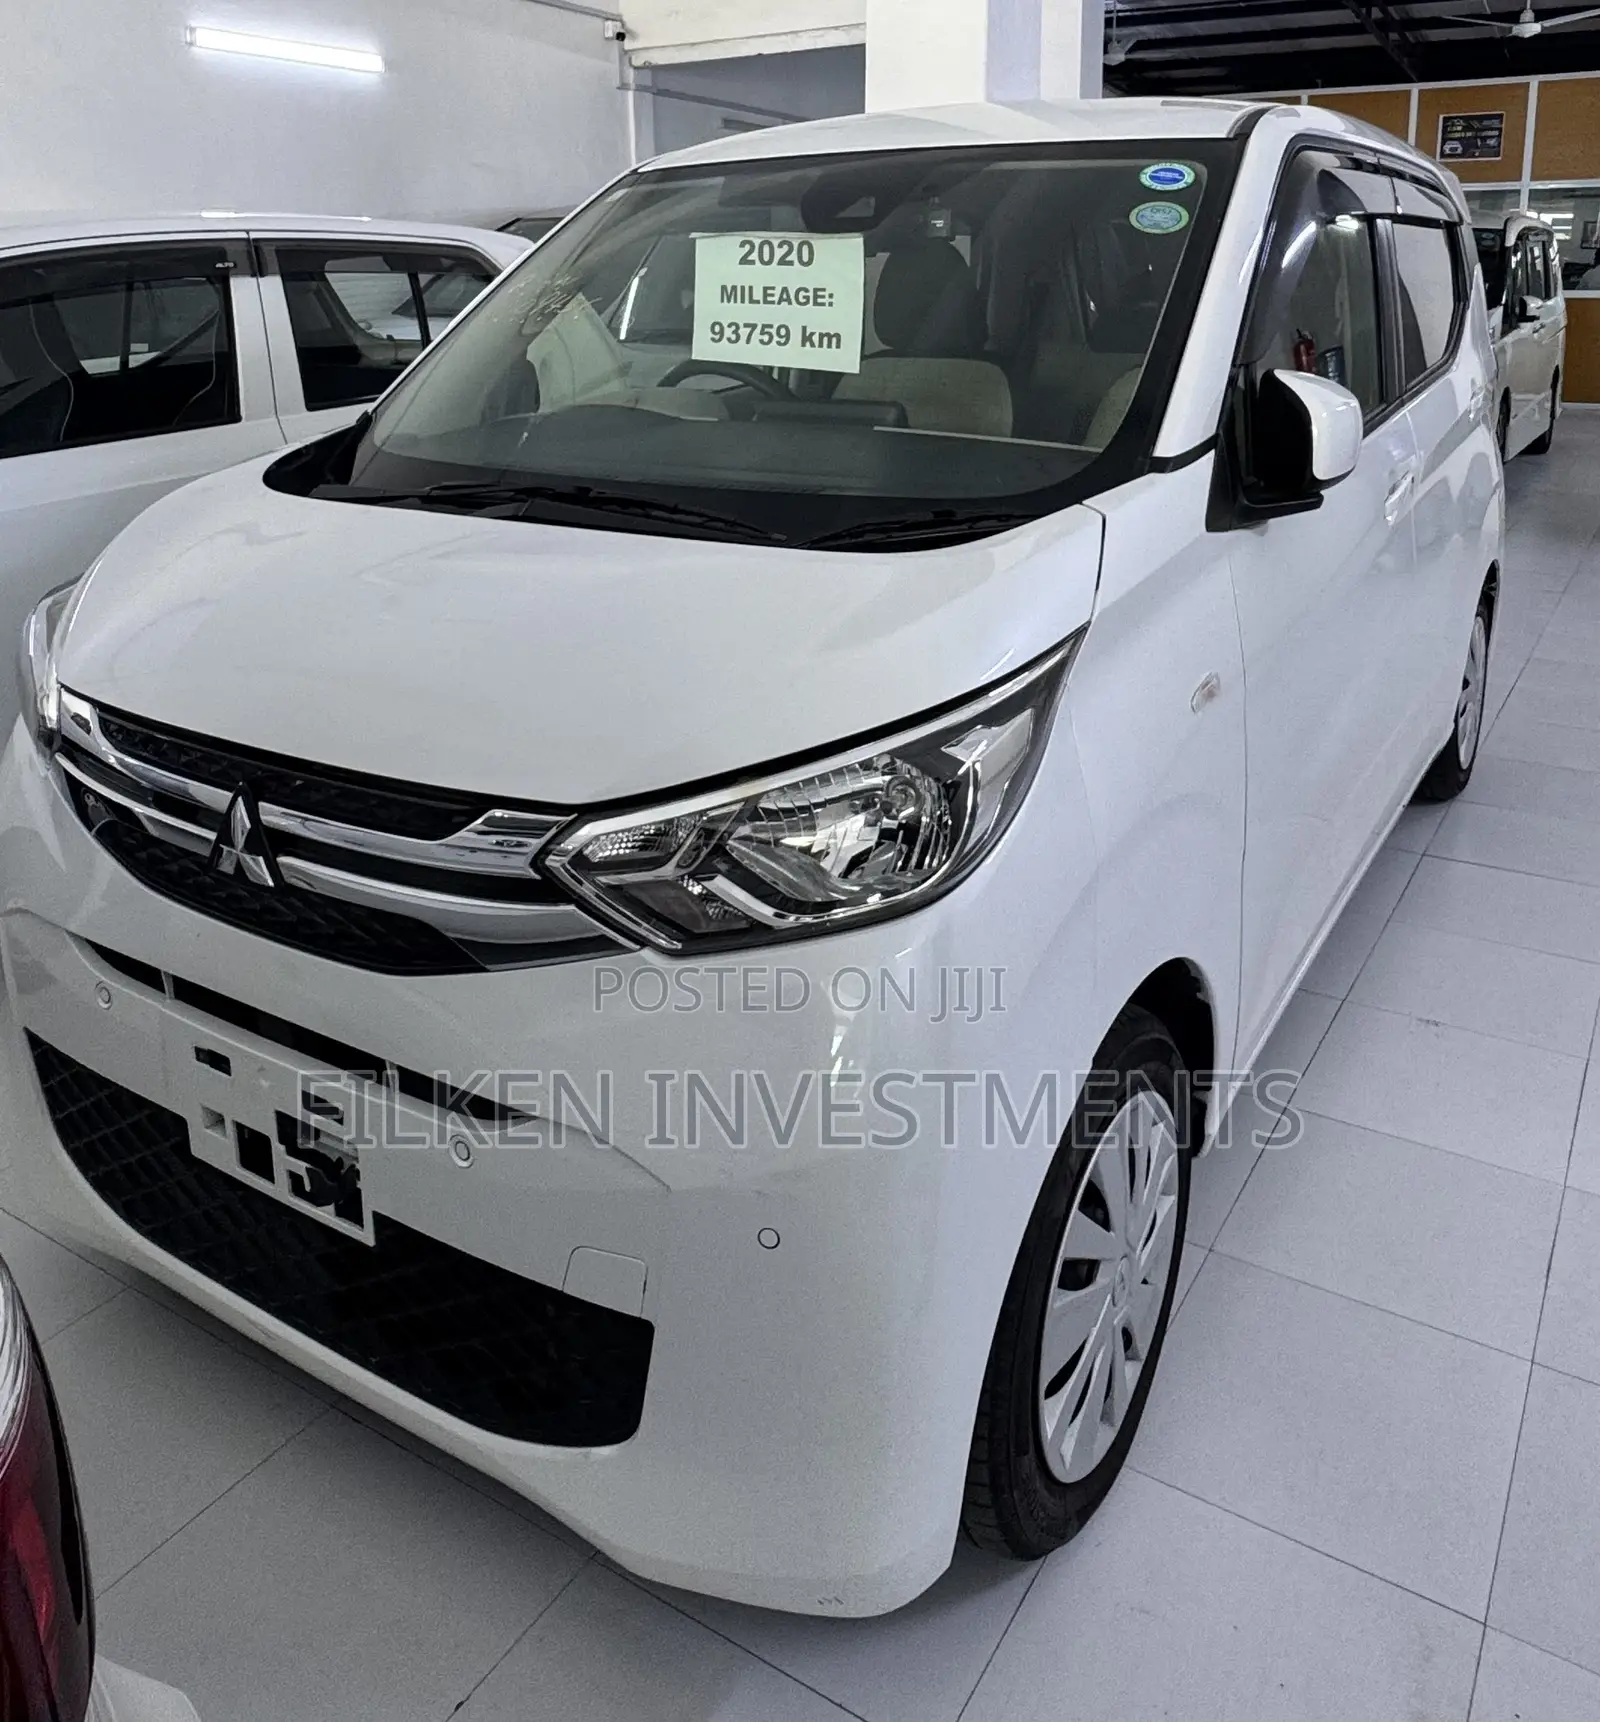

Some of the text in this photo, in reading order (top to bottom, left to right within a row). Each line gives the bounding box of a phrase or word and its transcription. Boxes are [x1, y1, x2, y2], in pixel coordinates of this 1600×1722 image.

[738, 239, 815, 267] 2020
[719, 284, 834, 307] MILEAGE:
[709, 321, 842, 349] 93759 km
